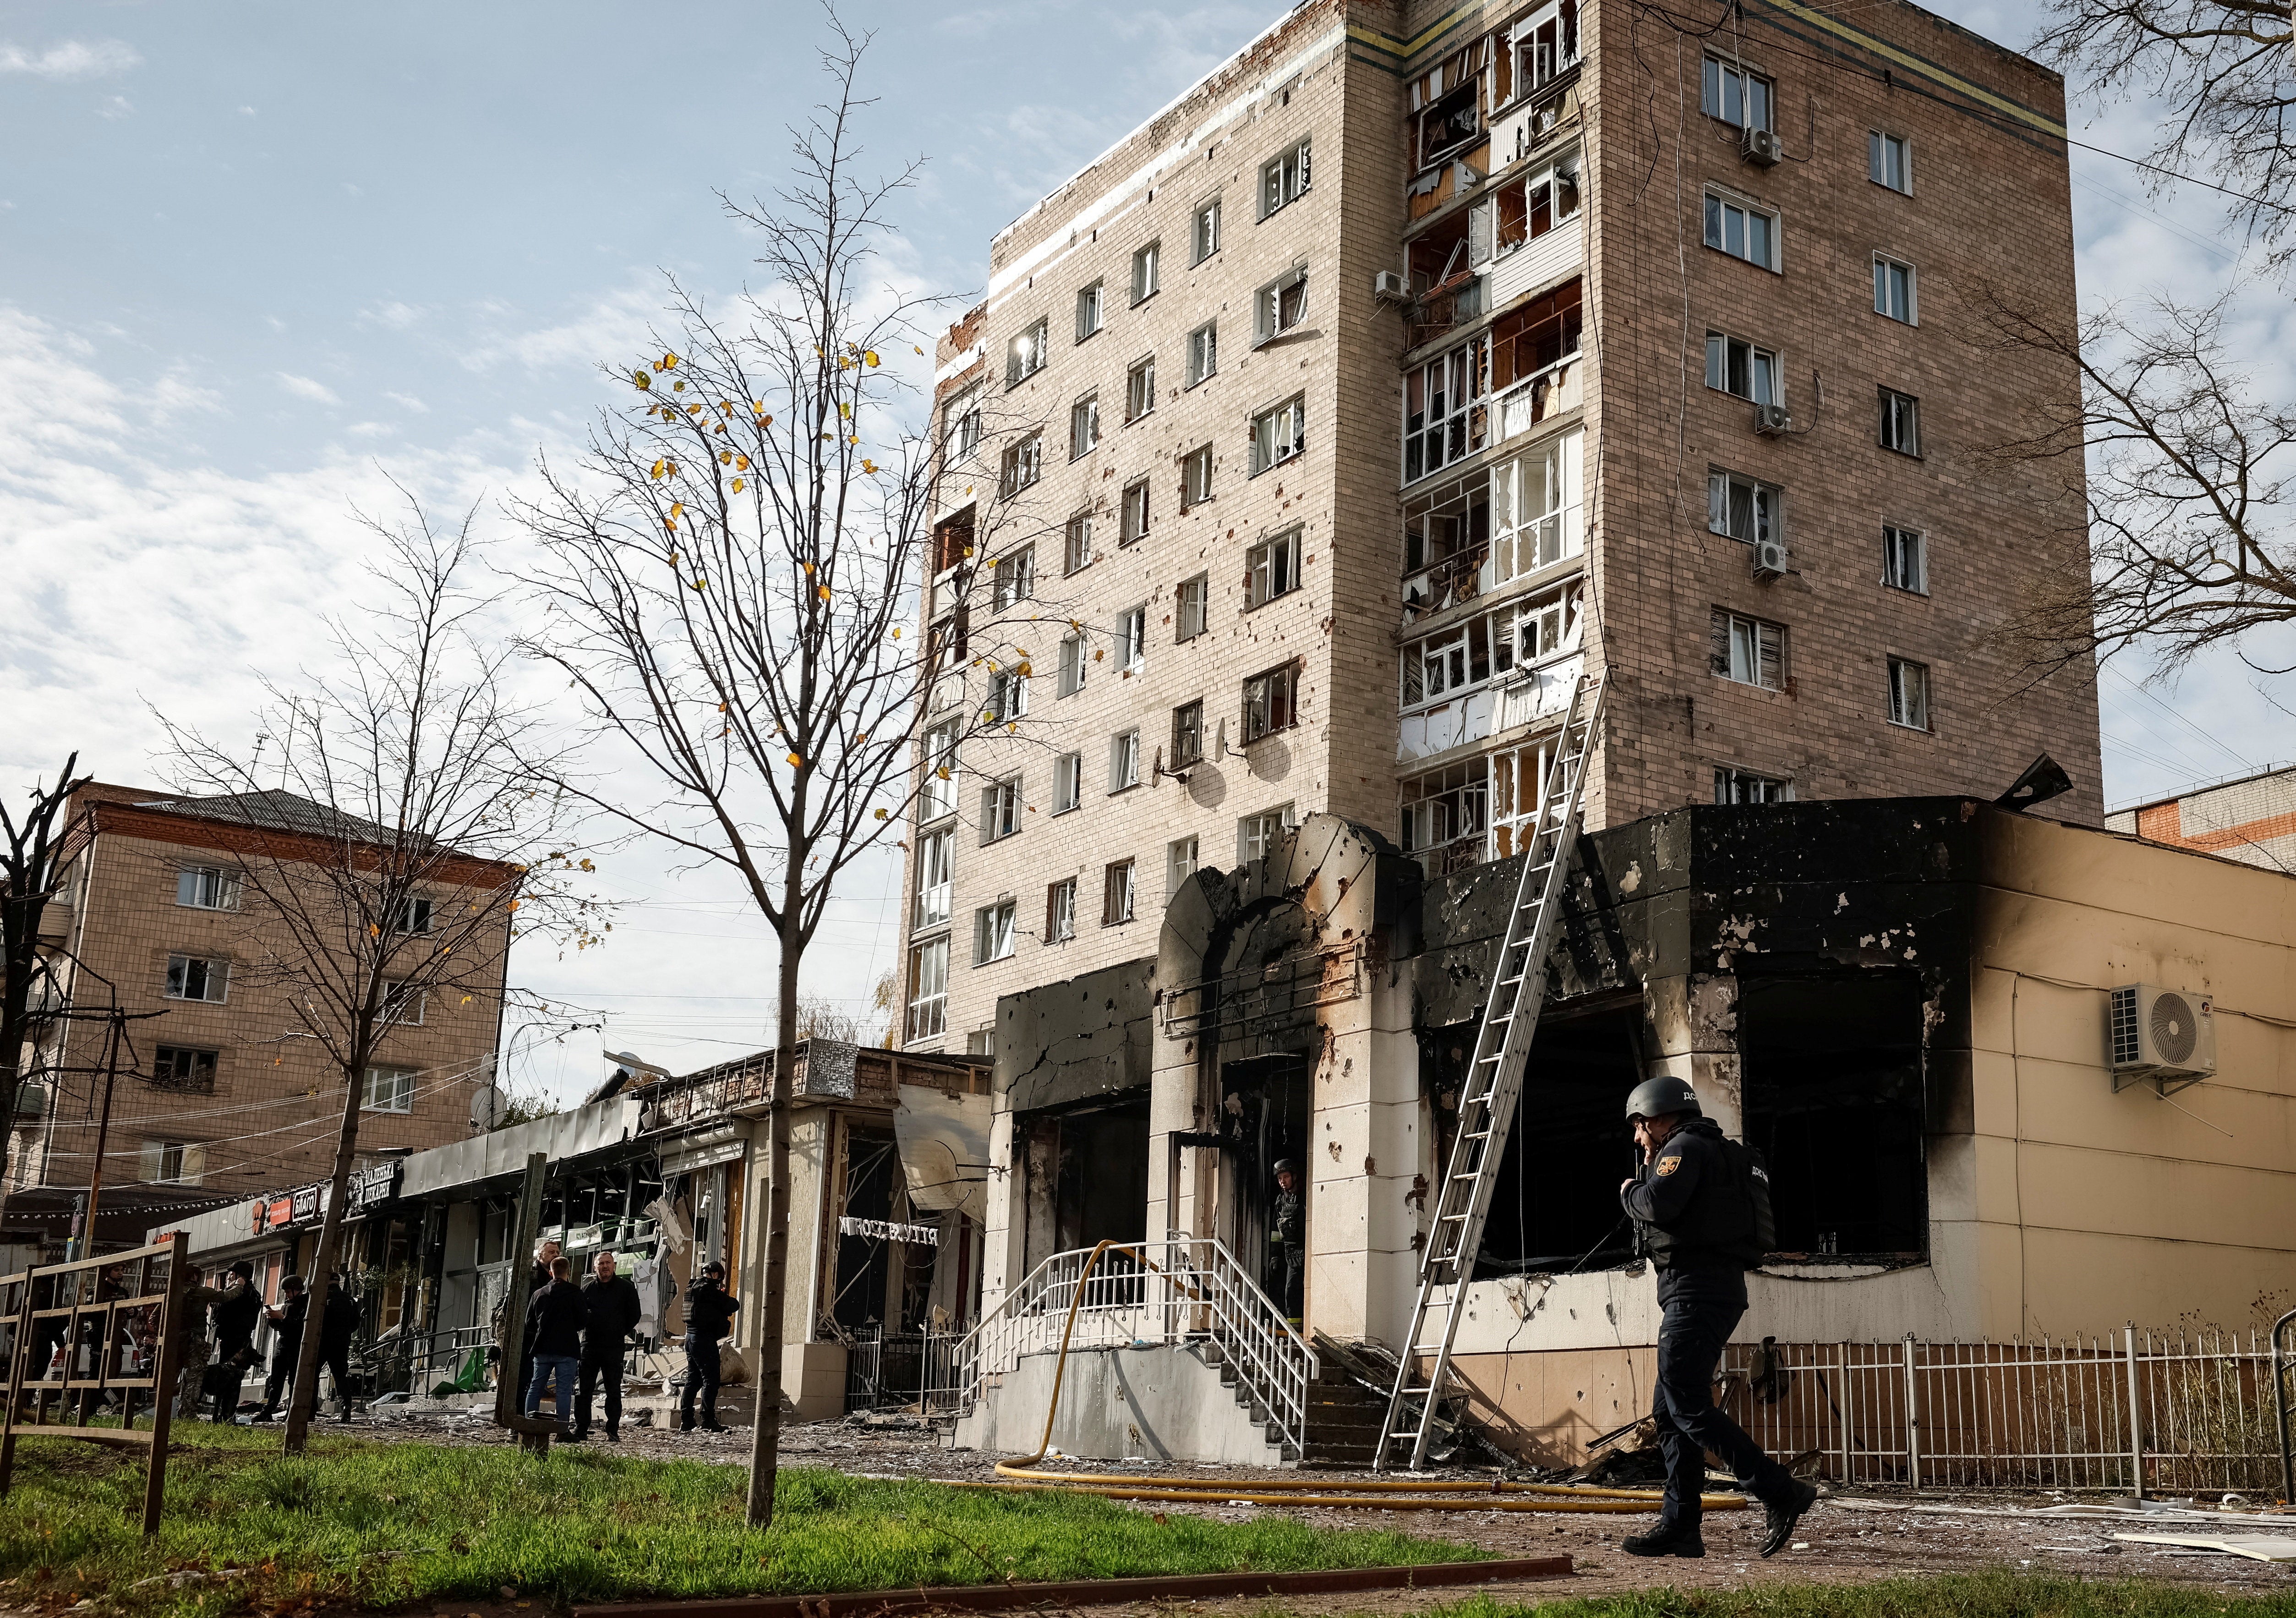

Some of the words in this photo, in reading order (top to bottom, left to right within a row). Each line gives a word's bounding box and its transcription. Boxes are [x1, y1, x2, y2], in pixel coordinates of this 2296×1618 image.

[1684, 1092, 1697, 1101] ДС
[365, 1163, 394, 1186] МАЛЕНЬКА
[1752, 1166, 1762, 1178] ДСНС
[365, 1181, 390, 1203] ПЕКАРНЯ
[295, 1195, 314, 1214] БЛАГО
